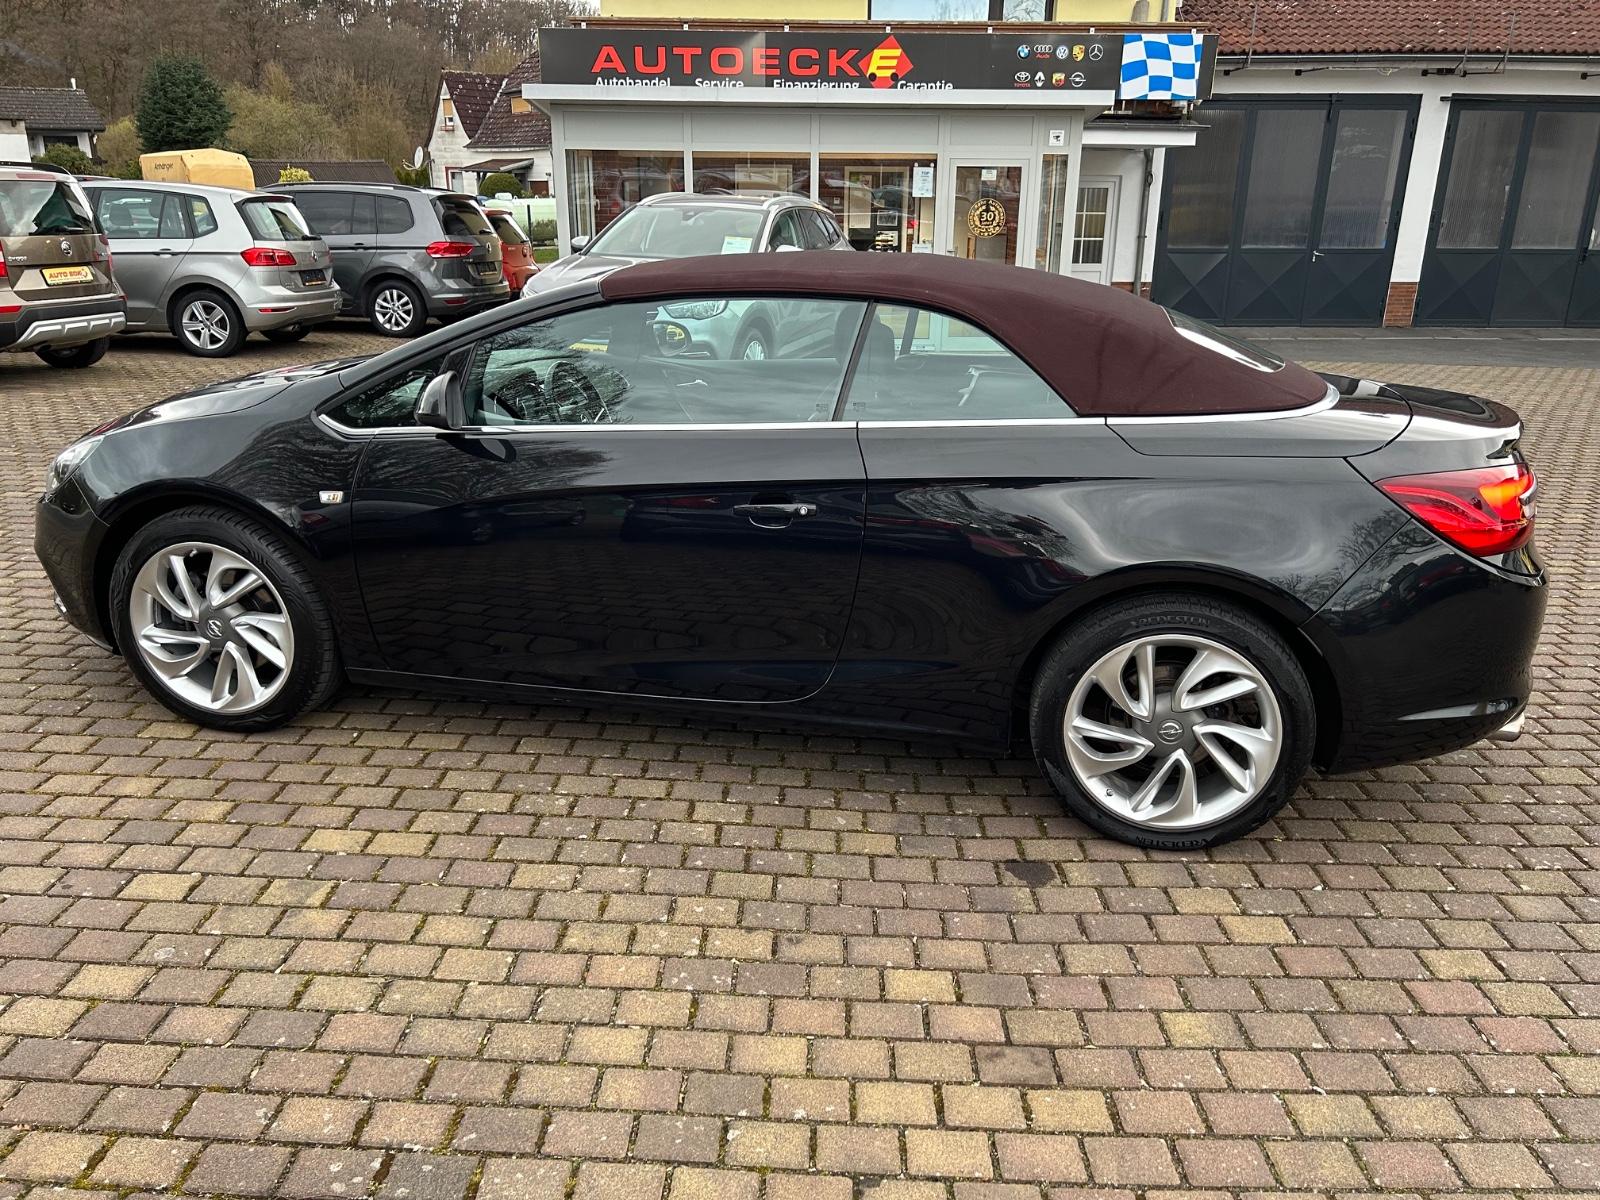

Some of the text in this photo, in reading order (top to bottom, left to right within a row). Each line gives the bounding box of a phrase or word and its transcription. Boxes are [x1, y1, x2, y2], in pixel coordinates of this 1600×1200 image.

[695, 77, 744, 88] Service
[897, 80, 954, 90] Garantie
[980, 211, 994, 221] 30
